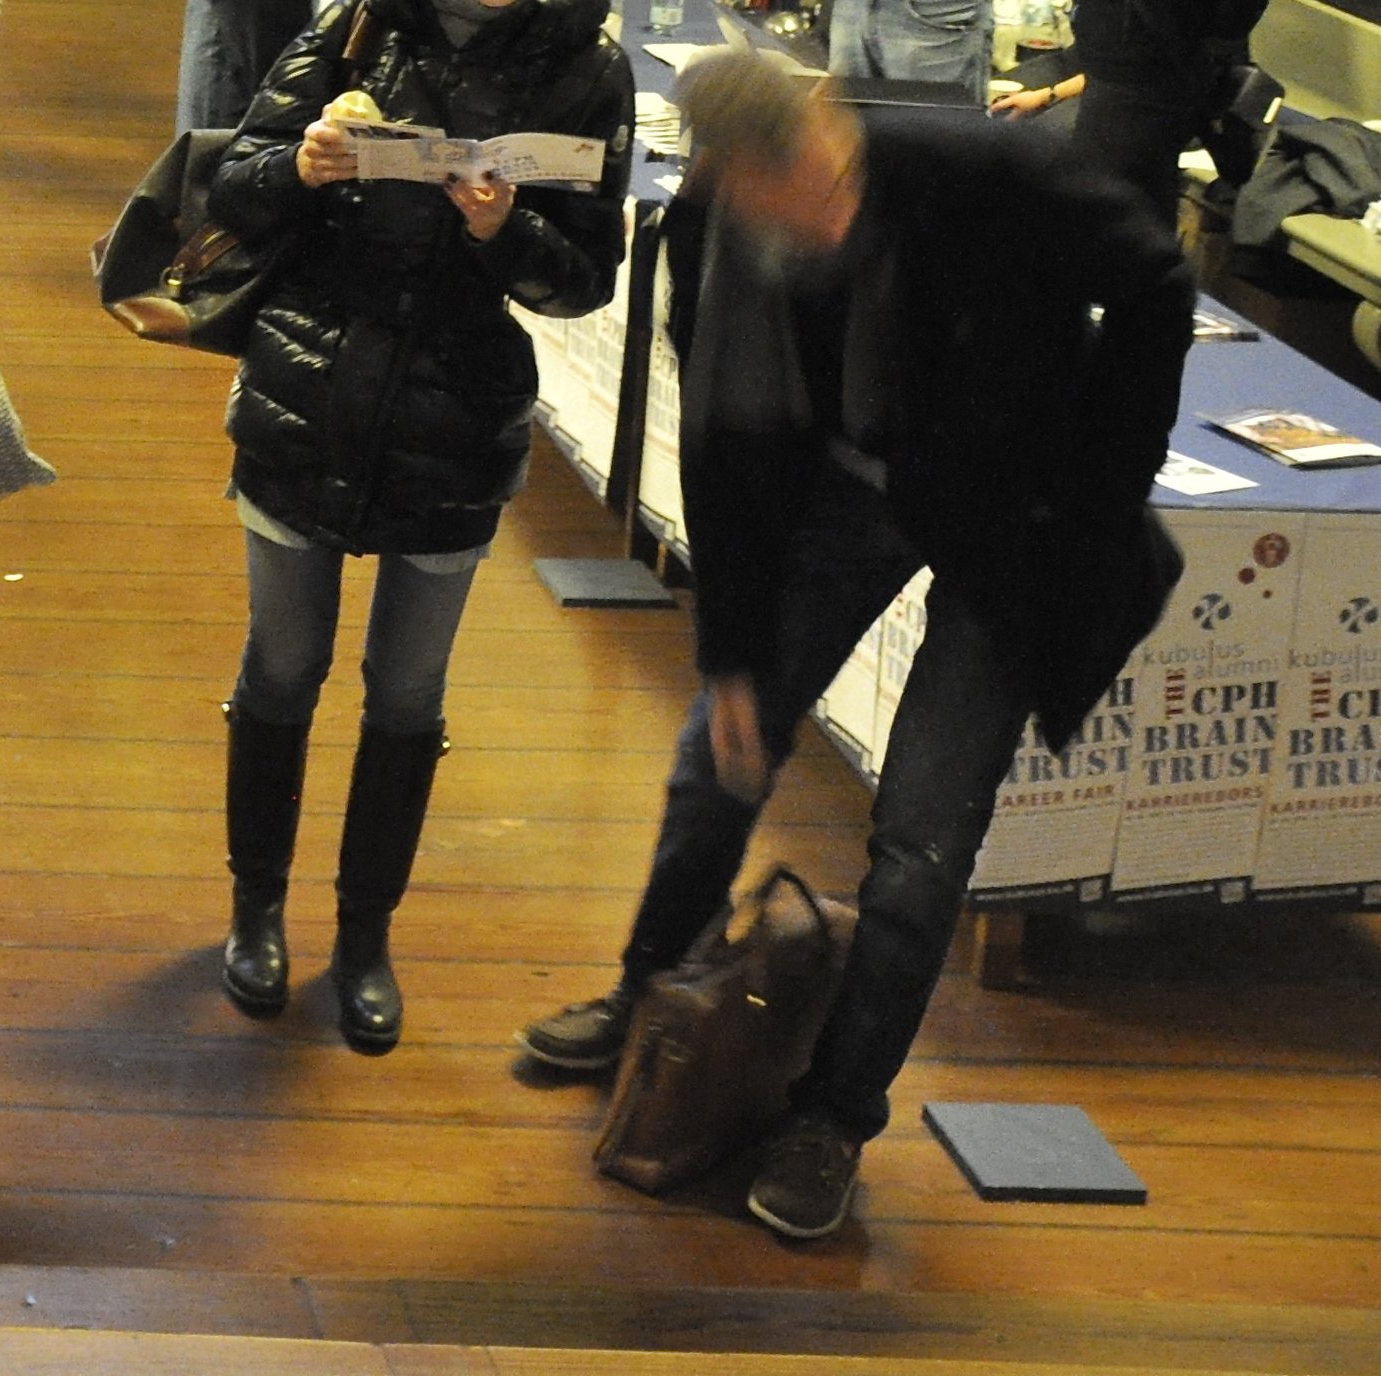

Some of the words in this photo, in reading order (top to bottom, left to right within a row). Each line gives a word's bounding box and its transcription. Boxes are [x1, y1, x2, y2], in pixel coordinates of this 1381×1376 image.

[1192, 680, 1278, 715] CPH
[1145, 714, 1278, 753] BRAIN
[1004, 746, 1132, 784] TRUST
[1142, 748, 1275, 786] TRUST
[1002, 789, 1065, 808] AREER
[1073, 783, 1115, 802] FAIR
